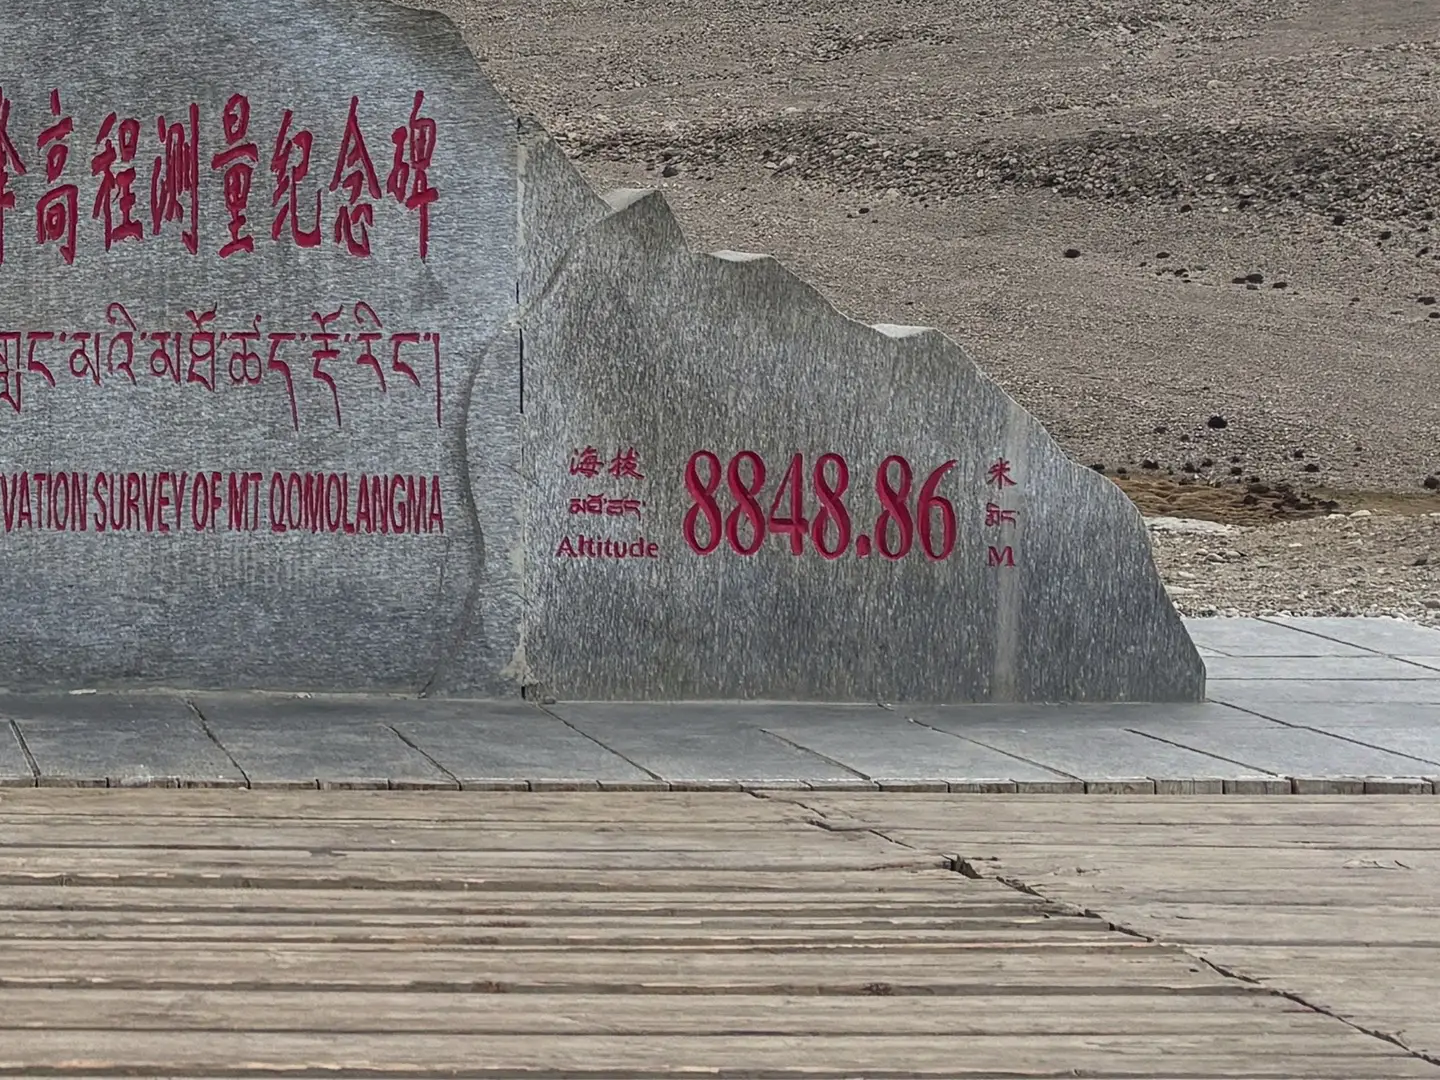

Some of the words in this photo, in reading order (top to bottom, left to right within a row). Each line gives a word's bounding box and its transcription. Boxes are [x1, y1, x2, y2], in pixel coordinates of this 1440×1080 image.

[569, 445, 646, 480] 海拔
[986, 457, 1018, 490] 米
[93, 471, 188, 534] SURVEY
[191, 471, 223, 533] OF
[227, 471, 263, 532] MT
[269, 471, 444, 535] QOMOLANGMA
[682, 449, 958, 562] 8848.86
[556, 534, 659, 558] Altitude
[987, 545, 1016, 567] M
